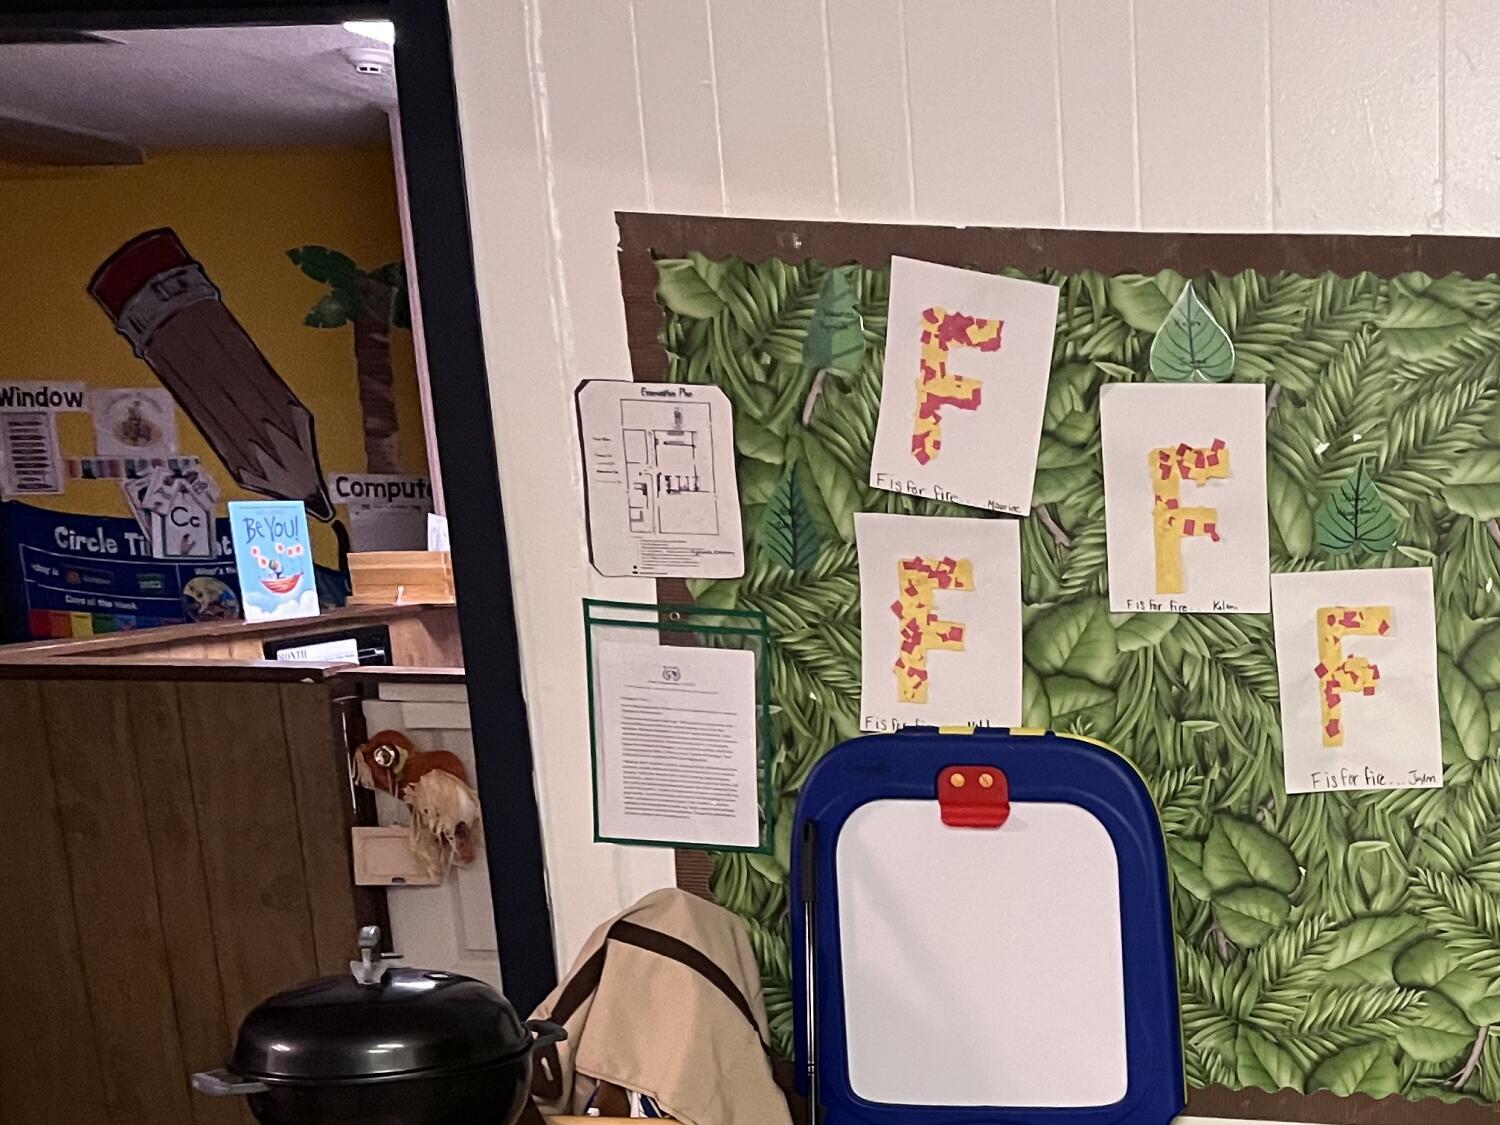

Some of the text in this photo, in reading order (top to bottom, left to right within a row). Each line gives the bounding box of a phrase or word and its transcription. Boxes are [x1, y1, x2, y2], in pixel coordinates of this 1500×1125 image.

[0, 386, 83, 408] Window
[876, 473, 887, 486] F
[906, 480, 925, 496] for
[54, 525, 150, 556] Circle Ti
[1127, 599, 1134, 610] F
[1149, 599, 1162, 611] for
[1311, 771, 1321, 789] F
[1325, 771, 1338, 789] is
[1340, 767, 1359, 787] for
